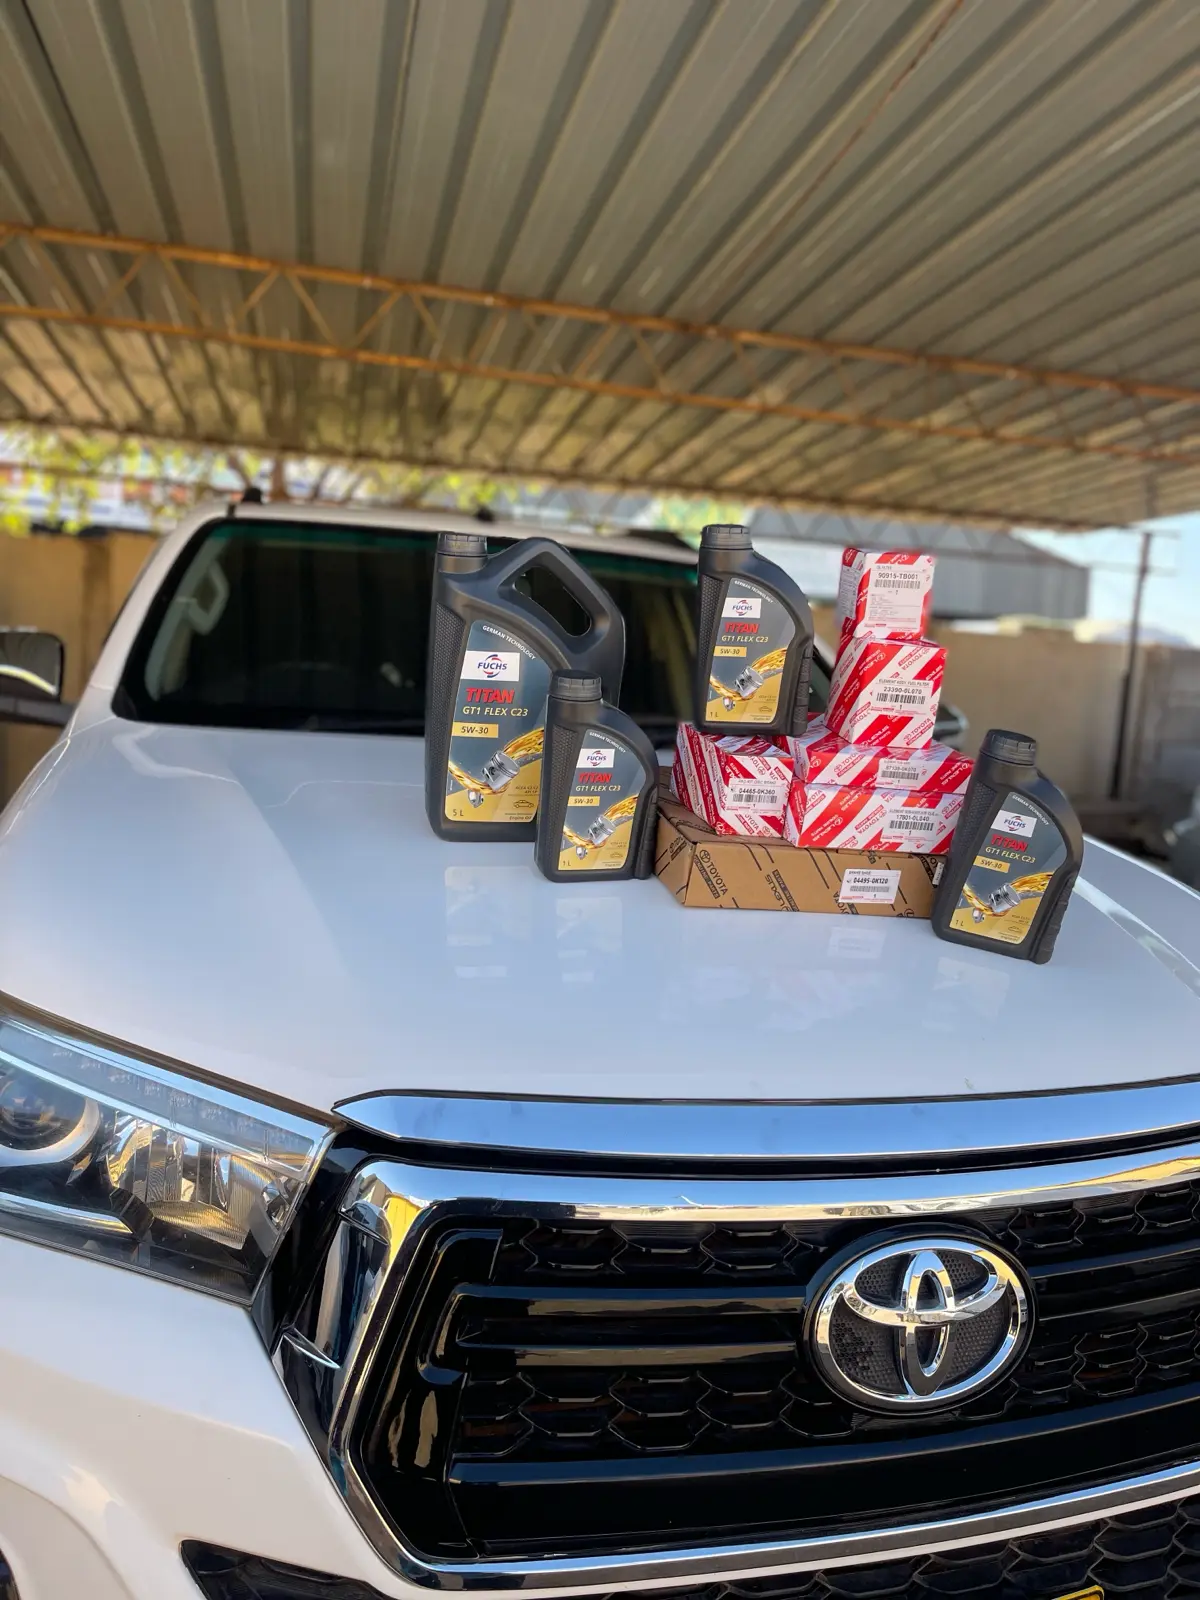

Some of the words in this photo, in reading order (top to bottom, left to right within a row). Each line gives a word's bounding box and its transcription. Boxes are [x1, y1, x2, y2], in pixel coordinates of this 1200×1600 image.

[725, 622, 760, 634] TITAN
[482, 625, 506, 638] GERMAN
[505, 635, 536, 660] TECHNOLOGY
[477, 662, 508, 670] FUCHS
[466, 687, 515, 704] TITAN
[462, 706, 481, 715] GT1
[484, 707, 507, 716] FLEX
[510, 708, 528, 717] C23
[461, 726, 488, 734] 5W-30
[578, 772, 612, 783] TITAN
[744, 814, 759, 830] OYOTA
[1004, 819, 1026, 828] FUCHS
[991, 834, 1028, 852] TITAN
[985, 846, 999, 855] GT1
[1001, 850, 1020, 860] FLEX
[1022, 856, 1036, 864] C23
[980, 860, 1002, 869] 5W-30
[706, 862, 728, 896] TOYOTA
